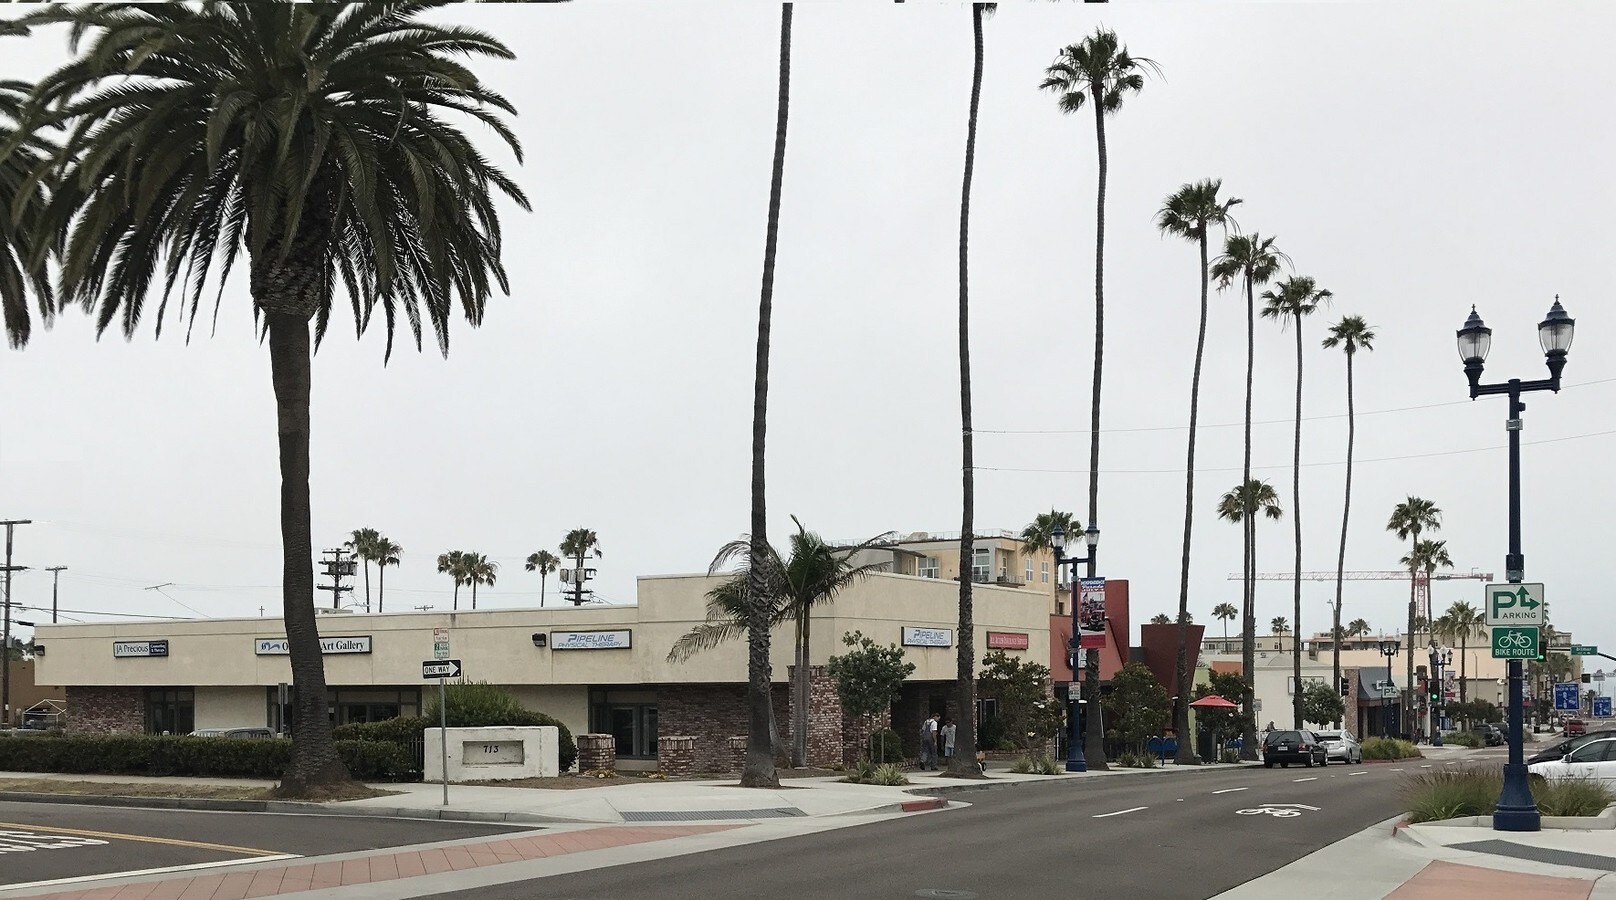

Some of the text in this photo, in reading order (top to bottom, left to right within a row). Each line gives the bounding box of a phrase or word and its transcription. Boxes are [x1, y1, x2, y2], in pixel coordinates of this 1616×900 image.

[568, 634, 615, 643] PIPELINE
[914, 629, 945, 640] PIPELINE
[116, 644, 123, 655] JA
[124, 644, 149, 653] Precious
[320, 640, 365, 652] Art Gallery
[1495, 648, 1535, 656] BIKE ROUTE
[424, 665, 450, 674] ONE WAY
[483, 745, 499, 754] 713
